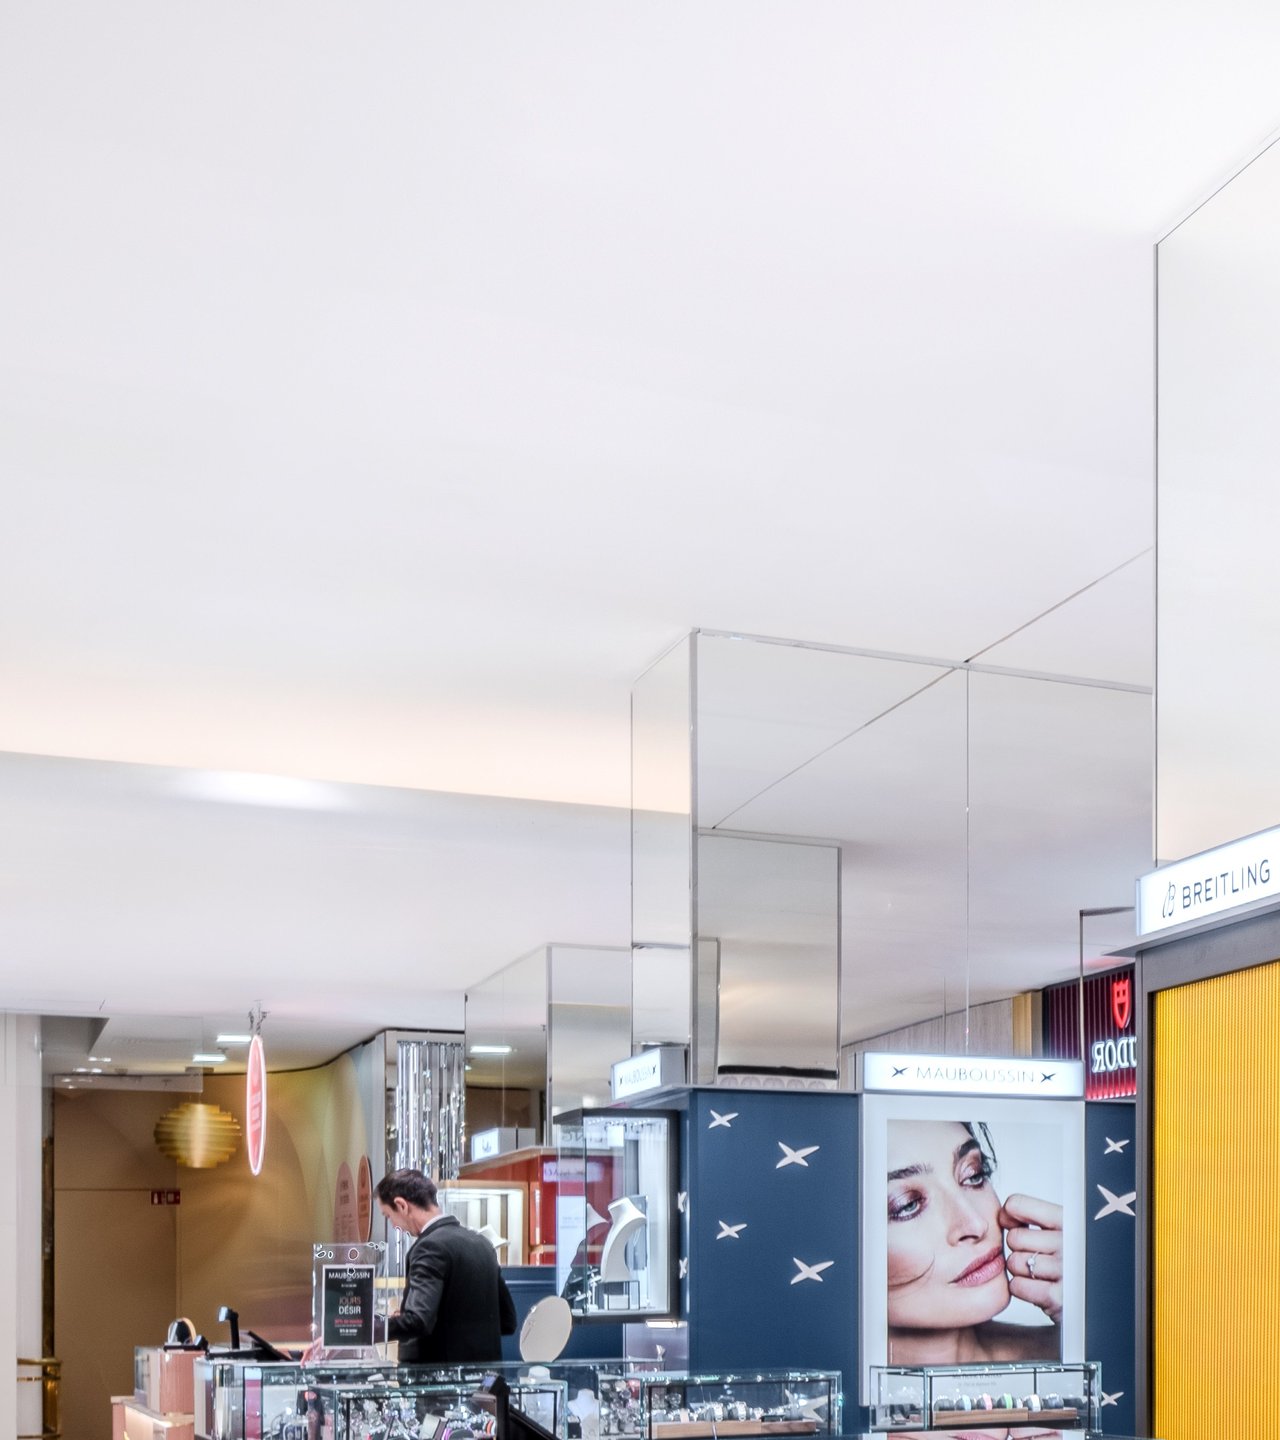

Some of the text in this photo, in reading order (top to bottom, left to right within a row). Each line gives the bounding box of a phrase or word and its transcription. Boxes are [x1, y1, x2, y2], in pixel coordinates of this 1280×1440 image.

[1182, 859, 1270, 909] BREITLING
[916, 1065, 1034, 1083] MAUBOUSSIN
[338, 1305, 361, 1315] DÉSIR
